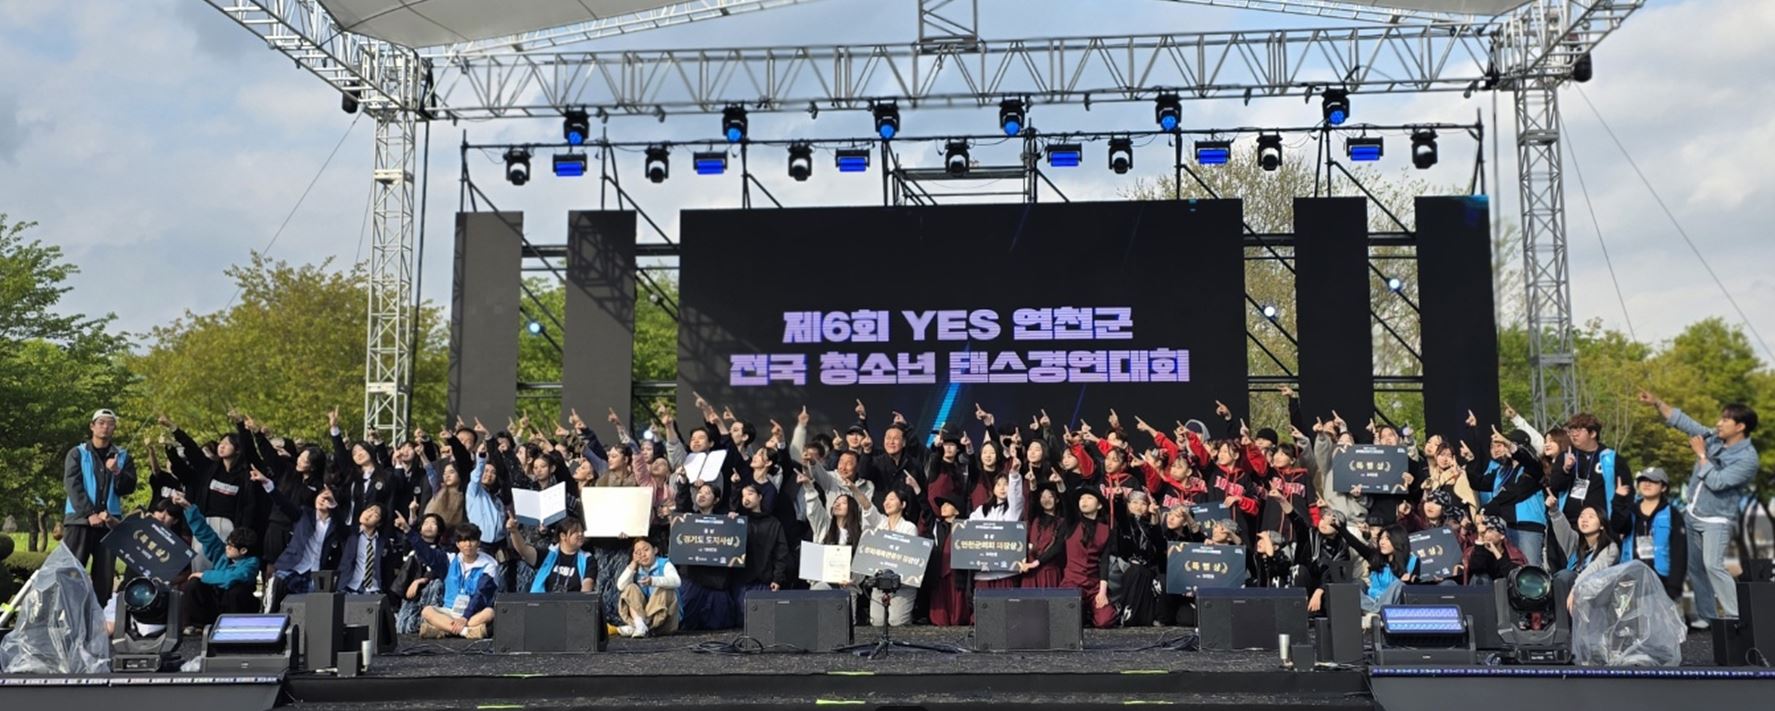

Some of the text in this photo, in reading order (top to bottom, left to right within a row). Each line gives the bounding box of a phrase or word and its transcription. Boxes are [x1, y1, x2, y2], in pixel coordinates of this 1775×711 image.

[783, 306, 1133, 342] 제6회 YES 연천군
[730, 348, 1190, 386] 전국 청소년 댄스경연대회
